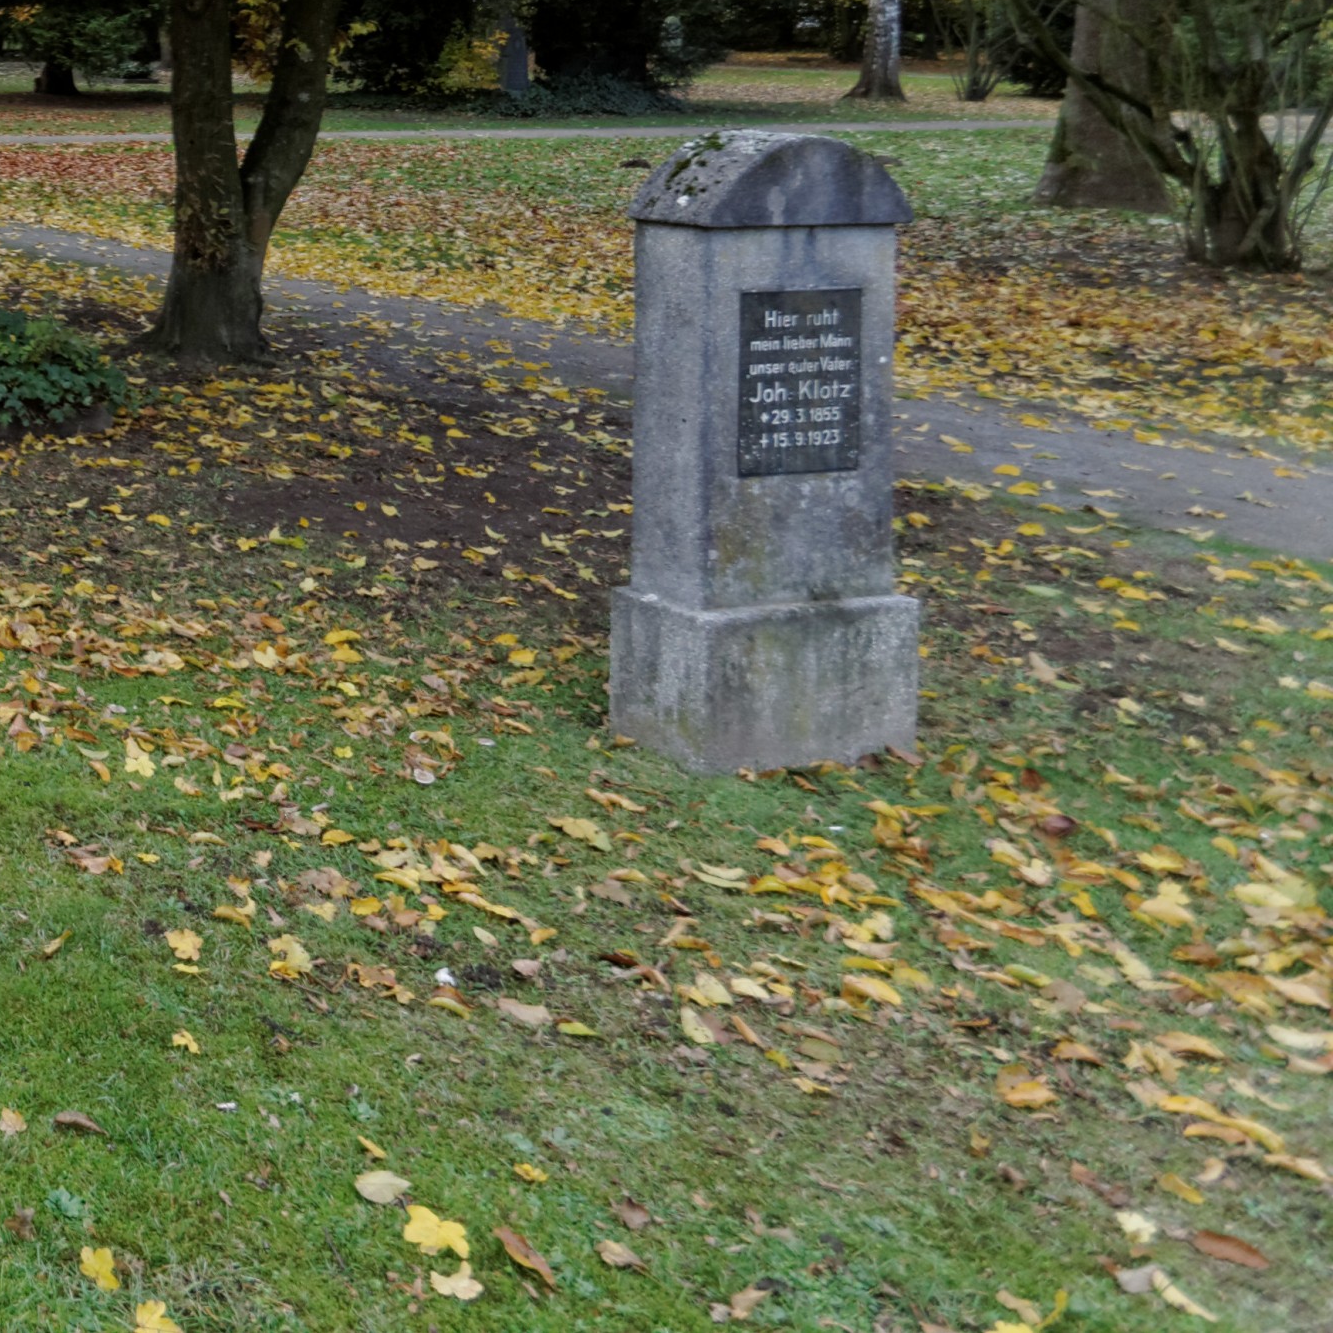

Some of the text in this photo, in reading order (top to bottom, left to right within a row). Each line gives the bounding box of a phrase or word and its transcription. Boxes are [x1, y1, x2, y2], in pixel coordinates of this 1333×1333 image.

[764, 308, 840, 328] Hier ruht
[750, 333, 853, 352] mein lieber Mann
[749, 362, 785, 376] unser
[788, 359, 819, 375] guter
[798, 380, 851, 401] Klotz
